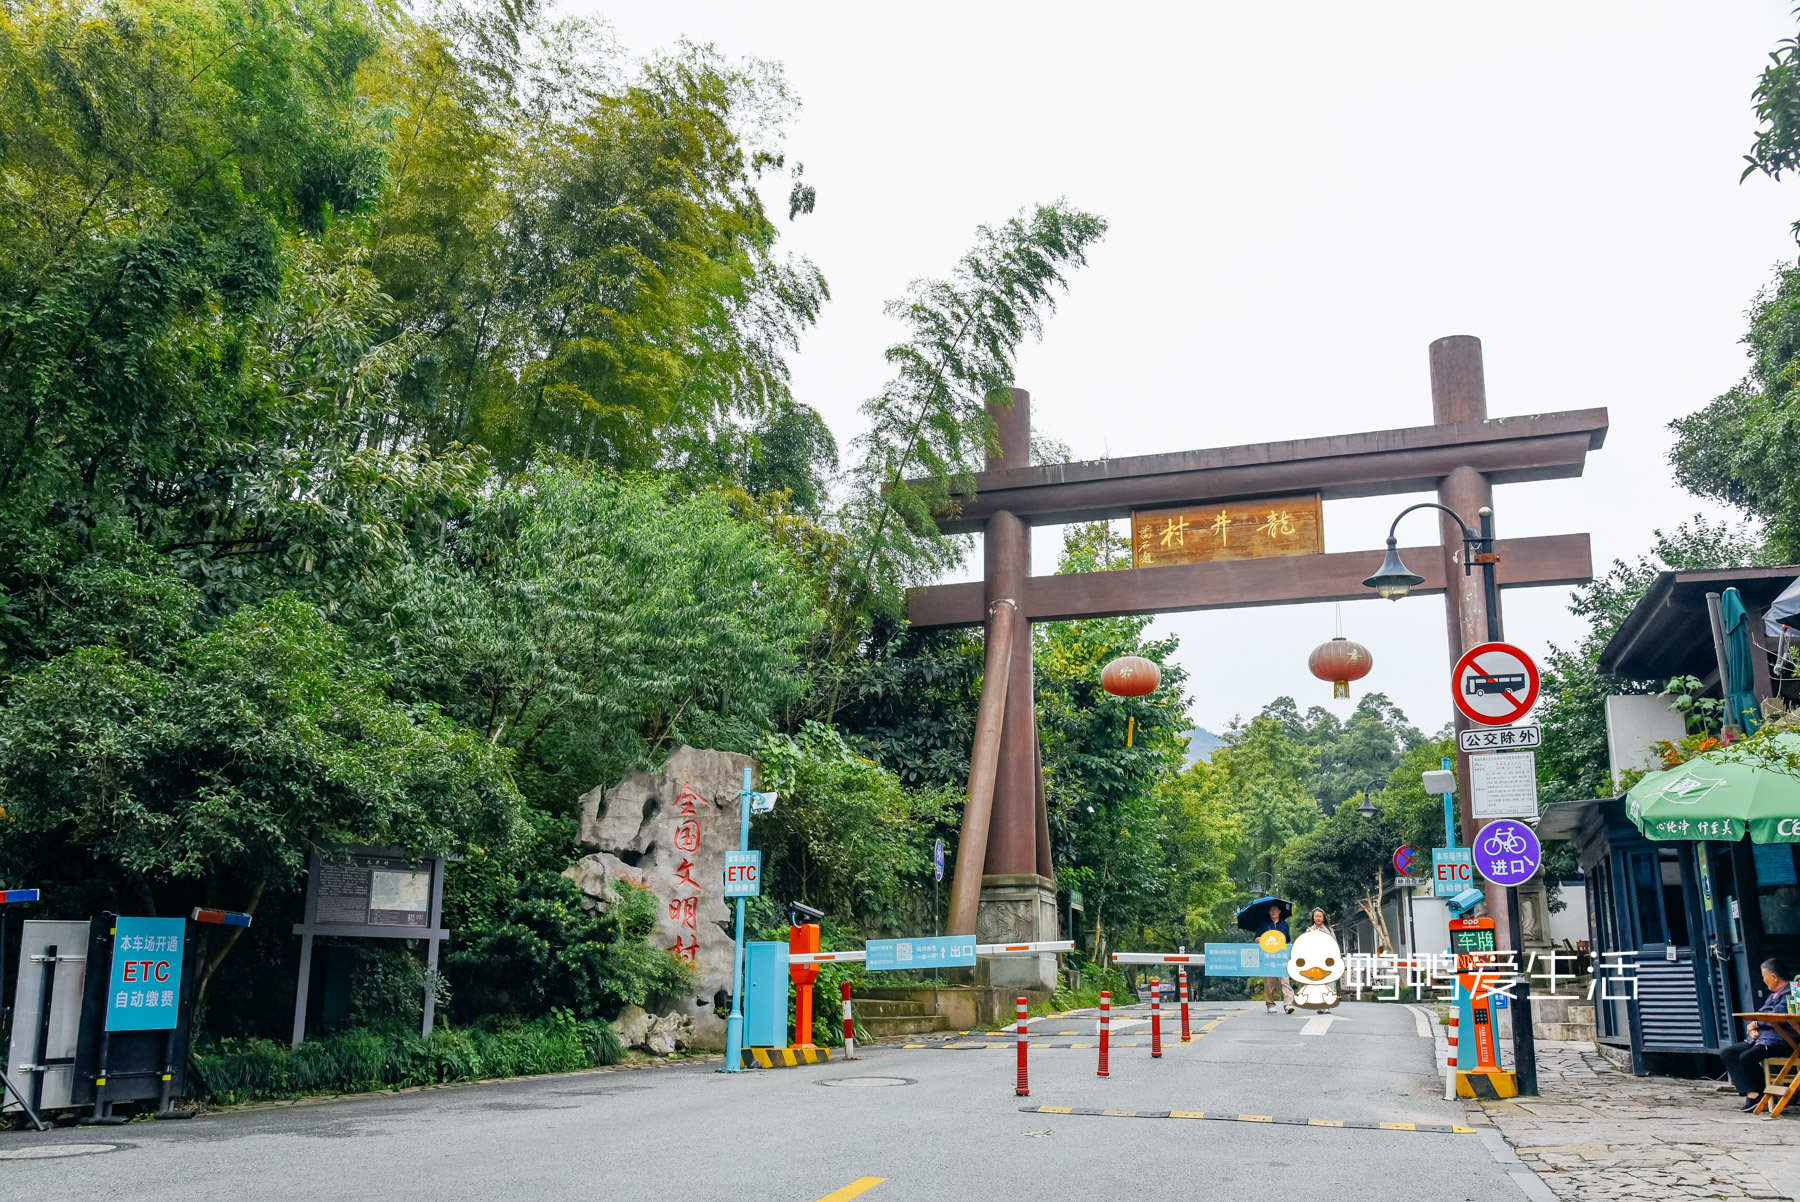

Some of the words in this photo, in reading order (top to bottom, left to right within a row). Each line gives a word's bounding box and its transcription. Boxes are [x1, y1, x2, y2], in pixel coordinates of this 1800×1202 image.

[1466, 730, 1535, 747] 公交除外
[1436, 851, 1469, 861] 本车场开通
[728, 865, 757, 882] ETC
[1437, 863, 1471, 881] ETC
[1491, 859, 1525, 876] 进口
[667, 781, 708, 972] 全国文明村
[120, 935, 179, 952] 本车场开通
[1457, 930, 1494, 952] 车牌
[949, 944, 973, 958] 出口
[123, 960, 170, 982] ETC
[115, 990, 174, 1008] 自动缴费
